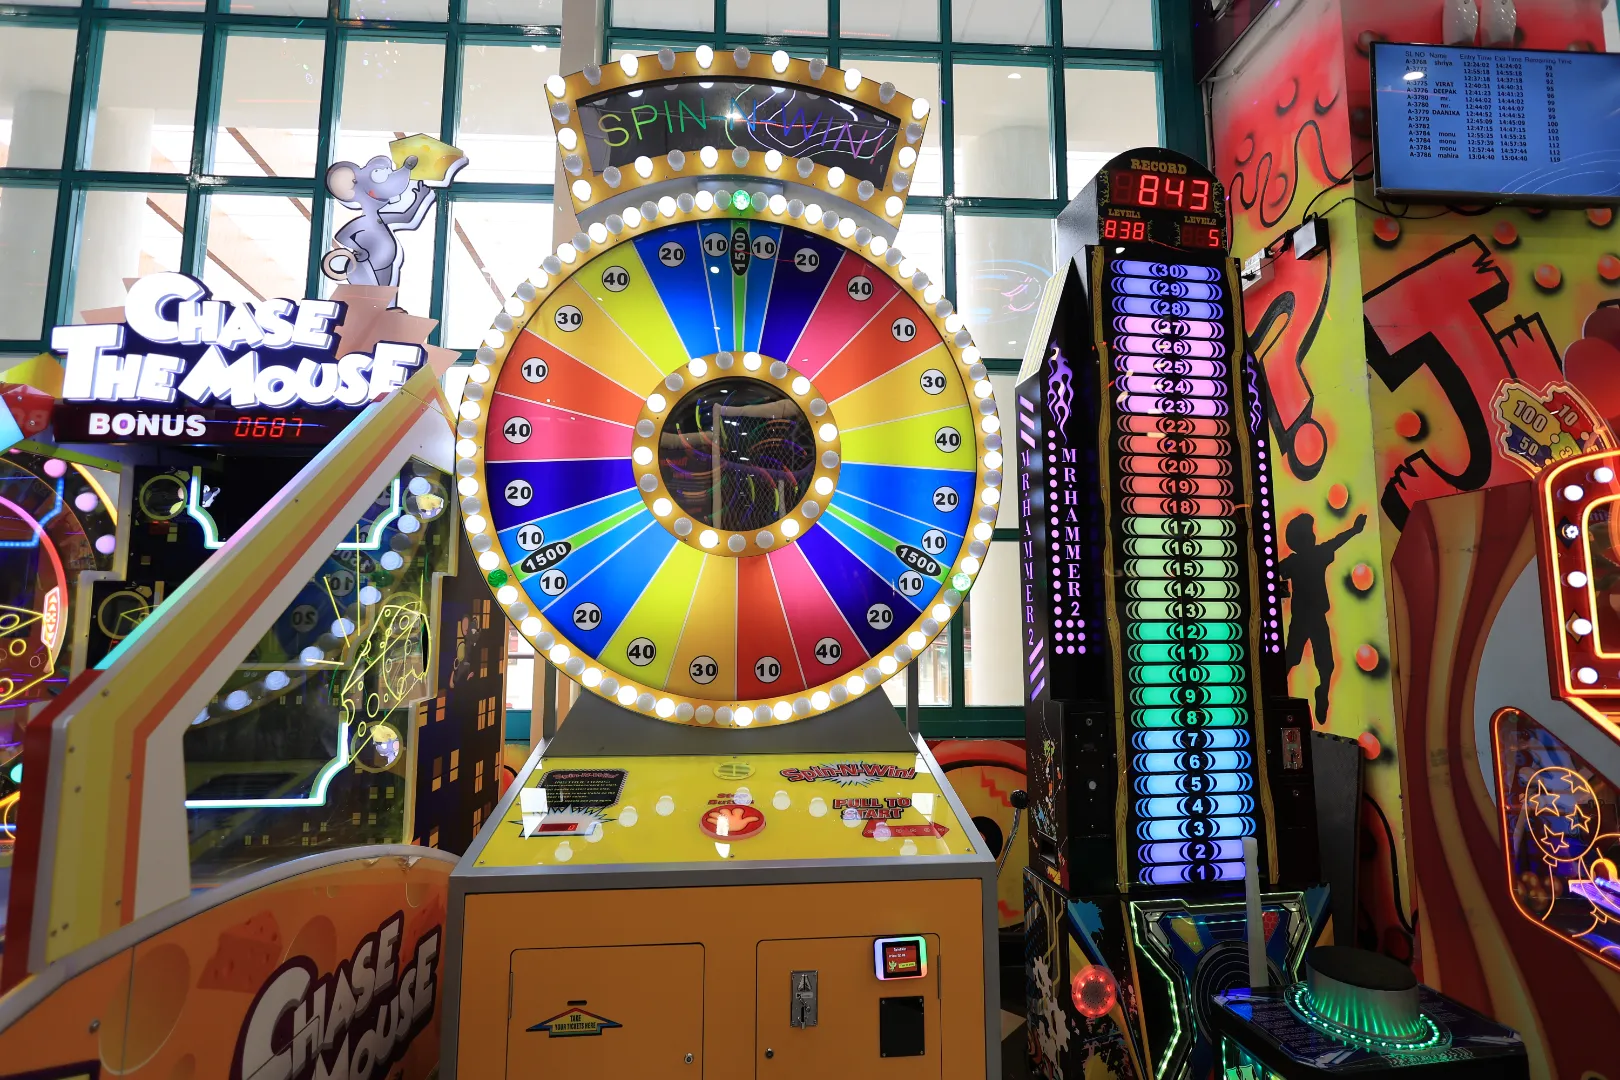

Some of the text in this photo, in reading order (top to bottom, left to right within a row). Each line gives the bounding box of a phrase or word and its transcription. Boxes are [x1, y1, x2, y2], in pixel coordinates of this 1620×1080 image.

[1131, 158, 1187, 175] RECORD
[1138, 174, 1209, 211] 843
[1108, 208, 1141, 219] LEVEL1
[1184, 215, 1217, 226] LEVEL2
[1104, 219, 1145, 241] 838
[1208, 229, 1219, 247] 5
[705, 239, 727, 251] 10
[735, 232, 746, 270] 1500
[754, 242, 775, 254] 10
[661, 248, 684, 261] 20
[796, 254, 819, 266] 20
[1157, 264, 1179, 277] 30
[604, 272, 628, 286] 40
[848, 282, 872, 295] 40
[1159, 283, 1181, 296] 29
[125, 272, 339, 349] CHASE
[1160, 302, 1182, 316] 28
[557, 312, 581, 325] 30
[894, 324, 915, 336] 10
[1160, 322, 1183, 335] 27
[1162, 342, 1184, 354] 26
[51, 324, 421, 408] THE MOUSE
[524, 364, 546, 378] 10
[1164, 361, 1185, 374] 25
[923, 376, 945, 388] 30
[1164, 380, 1186, 393] 24
[1165, 399, 1186, 413] 23
[1513, 400, 1548, 433] 100
[1558, 404, 1579, 427] 10
[88, 412, 206, 437] BONUS
[234, 417, 303, 438] 0687
[504, 423, 530, 437] 40
[1165, 420, 1187, 433] 22
[936, 433, 960, 446] 40
[1520, 436, 1539, 456] 50
[1167, 440, 1188, 453] 21
[1168, 461, 1189, 473] 20
[507, 486, 531, 500] 20
[1169, 481, 1189, 493] 19
[935, 493, 958, 505] 20
[1170, 501, 1191, 514] 18
[1170, 522, 1190, 535] 17
[519, 531, 542, 544] 10
[924, 536, 944, 548] 10
[1172, 542, 1192, 555] 16
[526, 543, 567, 571] 1500
[900, 547, 937, 574] 1500
[1173, 563, 1193, 576] 15
[542, 576, 565, 590] 10
[900, 577, 921, 590] 10
[1174, 584, 1195, 597] 14
[575, 609, 600, 623] 20
[869, 610, 892, 623] 20
[1175, 605, 1196, 617] 13
[1177, 626, 1197, 638] 12
[628, 644, 655, 659] 40
[816, 644, 841, 658] 40
[1177, 646, 1198, 659] 11
[692, 663, 717, 677] 30
[756, 664, 779, 677] 10
[1179, 667, 1200, 681] 10
[1186, 690, 1195, 702] 9
[1187, 711, 1197, 724] 8
[1188, 733, 1198, 746] 7
[1189, 755, 1200, 768] 6
[1191, 777, 1202, 791] 5
[833, 797, 912, 809] PULL TO
[1192, 799, 1203, 813] 4
[841, 808, 904, 819] START
[1194, 821, 1204, 835] 3
[1195, 845, 1206, 858] 2
[1197, 865, 1205, 879] 1
[241, 917, 401, 1080] CHASE
[567, 1022, 584, 1030] TICKETS
